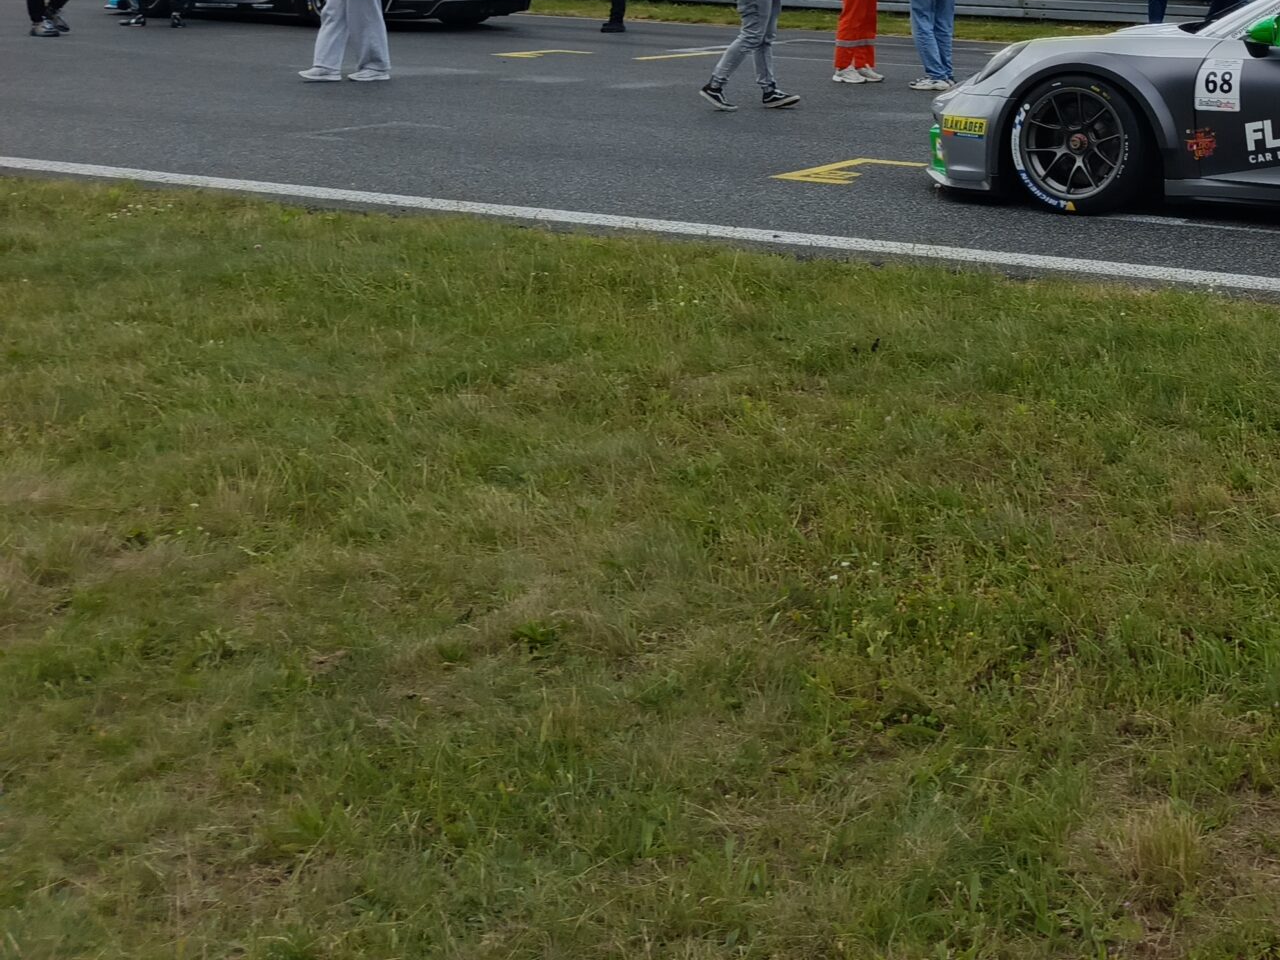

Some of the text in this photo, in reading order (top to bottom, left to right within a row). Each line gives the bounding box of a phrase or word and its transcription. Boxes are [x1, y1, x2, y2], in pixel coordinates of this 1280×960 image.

[1205, 71, 1233, 94] 68
[1248, 152, 1273, 164] CAR
[1020, 171, 1059, 206] MICHELIN
